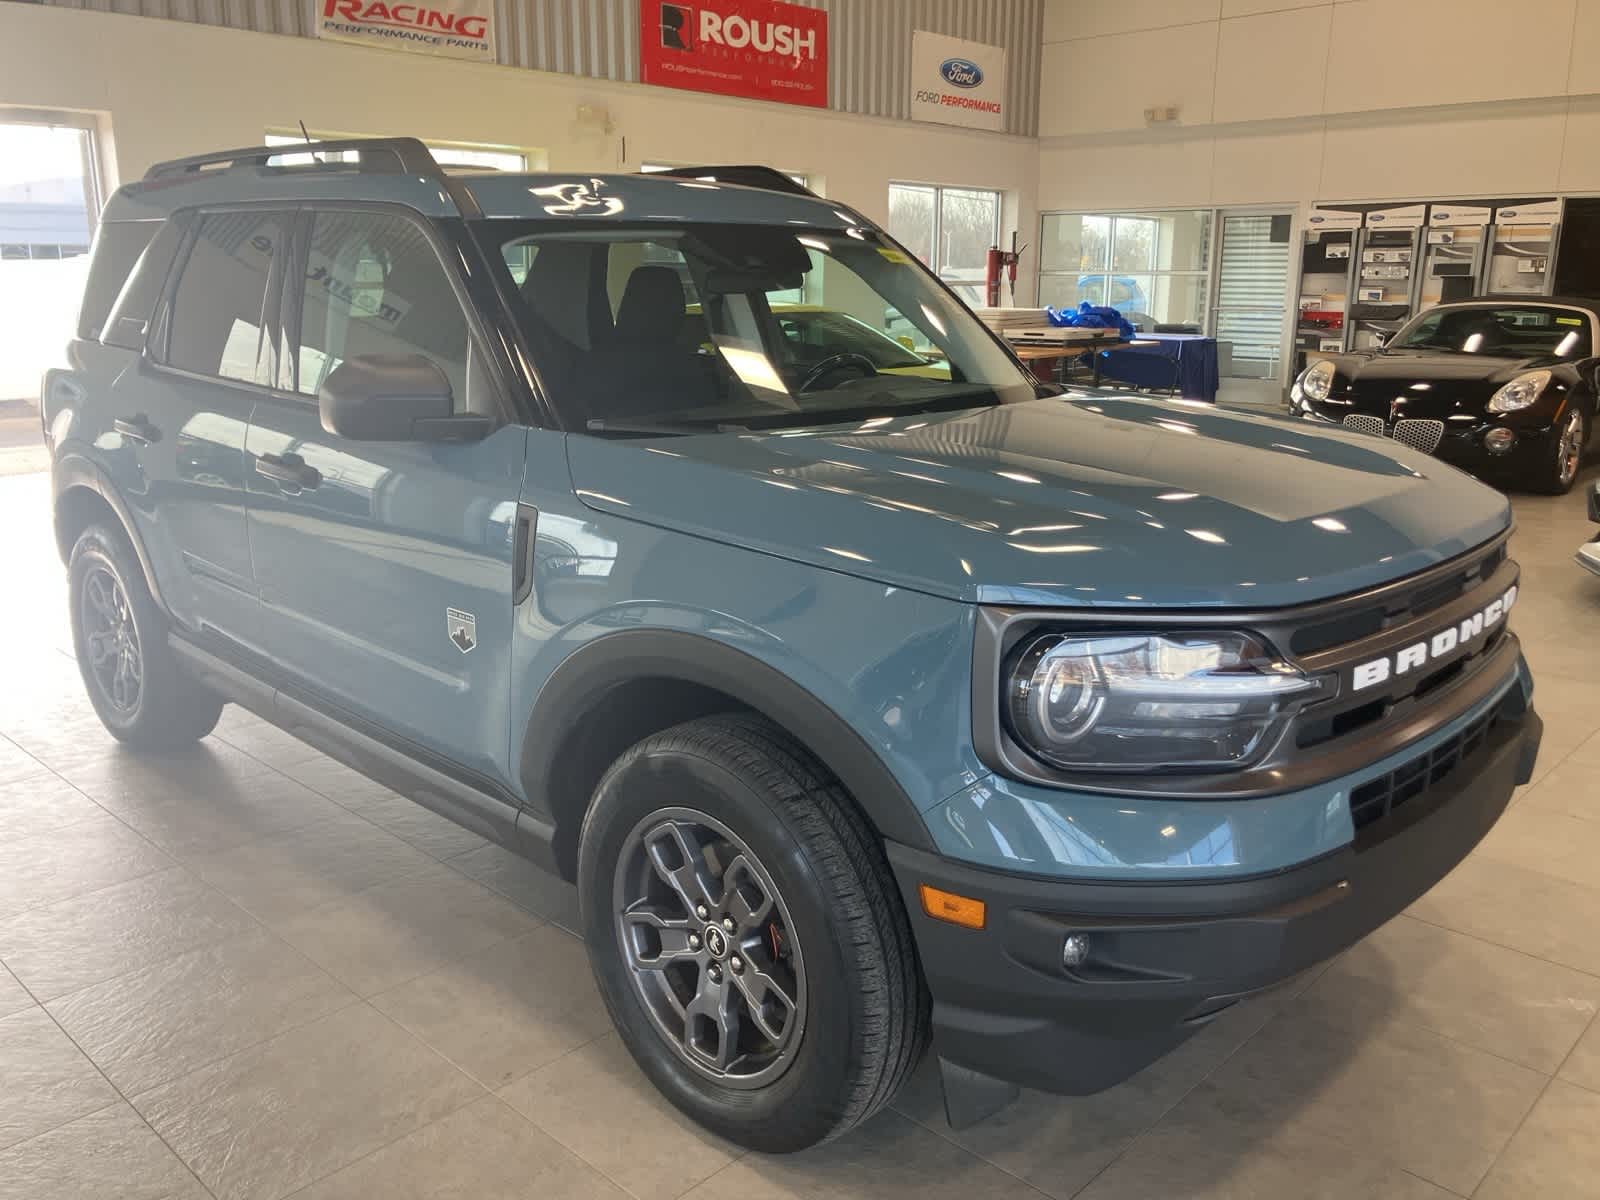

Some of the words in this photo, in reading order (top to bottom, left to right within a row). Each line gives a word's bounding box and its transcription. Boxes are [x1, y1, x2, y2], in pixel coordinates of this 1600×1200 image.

[323, 0, 488, 39] RACING
[699, 9, 816, 60] ROUSH
[324, 20, 442, 44] PERFORMANCE
[446, 38, 489, 51] PARTS
[948, 62, 976, 84] Ford
[915, 90, 940, 105] FORD
[940, 94, 1002, 114] PERFORMANCE
